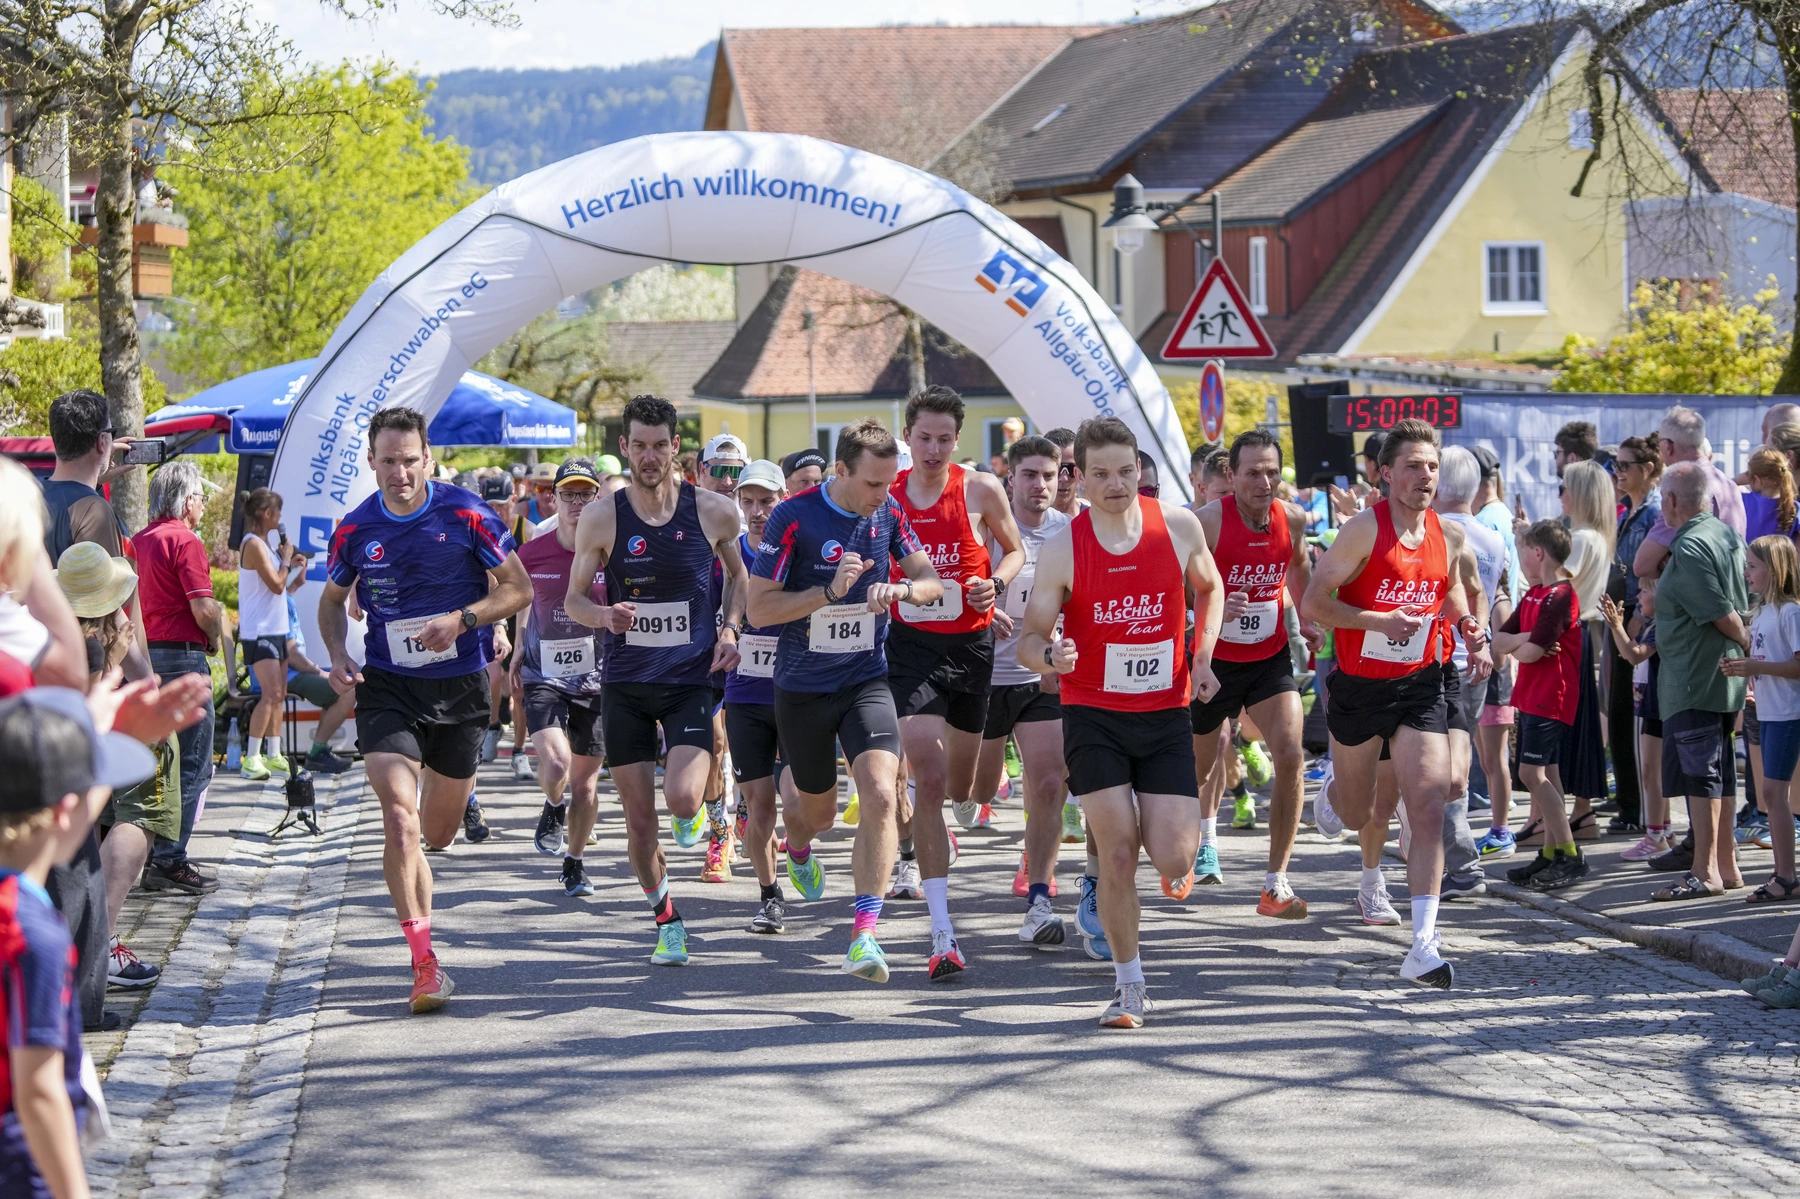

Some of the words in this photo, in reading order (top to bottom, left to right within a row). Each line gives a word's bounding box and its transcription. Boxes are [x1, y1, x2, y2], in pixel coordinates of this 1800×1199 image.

[561, 172, 685, 229] Herzlich
[693, 168, 902, 228] willkommen!
[1056, 302, 1128, 394] Volksbank
[330, 297, 462, 505] Allgäu-Oberschwaben
[461, 271, 489, 299] eG
[1346, 397, 1459, 429] 15:00:03
[240, 428, 282, 444] Augusti
[305, 391, 357, 497] Volksbank
[796, 454, 826, 468] DYNAFIT
[922, 542, 961, 554] ORT
[1108, 565, 1137, 573] SALOMON
[1231, 562, 1285, 575] SPORT
[1227, 572, 1283, 584] HASCHKO
[1379, 578, 1440, 592] SPORT
[1254, 585, 1280, 598] Team
[1375, 588, 1437, 603] HASCHKO
[1093, 592, 1166, 613] SPORT
[1094, 603, 1163, 622] HASCHKO
[630, 615, 688, 634] 20913
[828, 621, 862, 640] 184
[1125, 620, 1164, 636] Team
[1240, 615, 1261, 630] 98
[403, 636, 427, 654] 18
[553, 649, 583, 665] 426
[1128, 650, 1167, 658] Hergensweiler
[1124, 658, 1160, 677] 102
